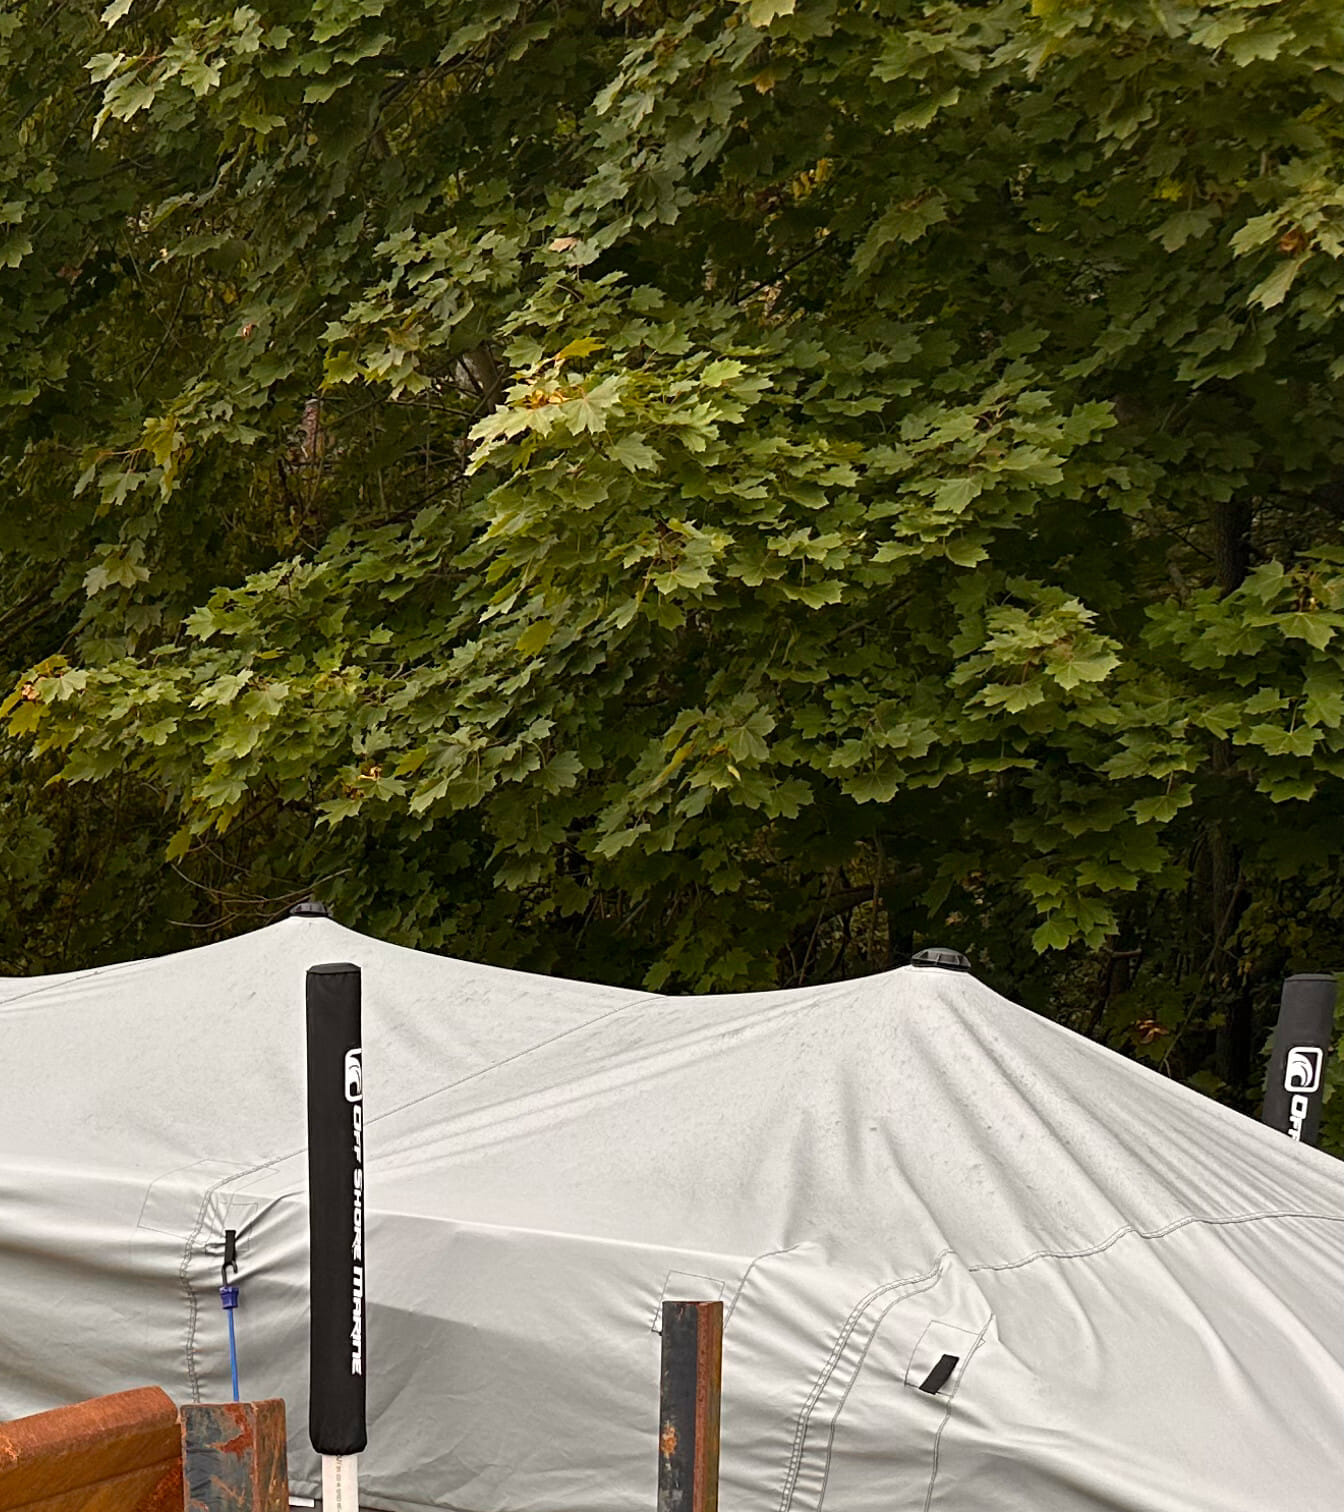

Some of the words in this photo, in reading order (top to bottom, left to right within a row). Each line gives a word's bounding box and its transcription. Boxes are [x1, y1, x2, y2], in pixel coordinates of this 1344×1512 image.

[353, 1104, 362, 1163] OFF
[352, 1168, 363, 1261] SHORE
[349, 1265, 363, 1376] MARINE
